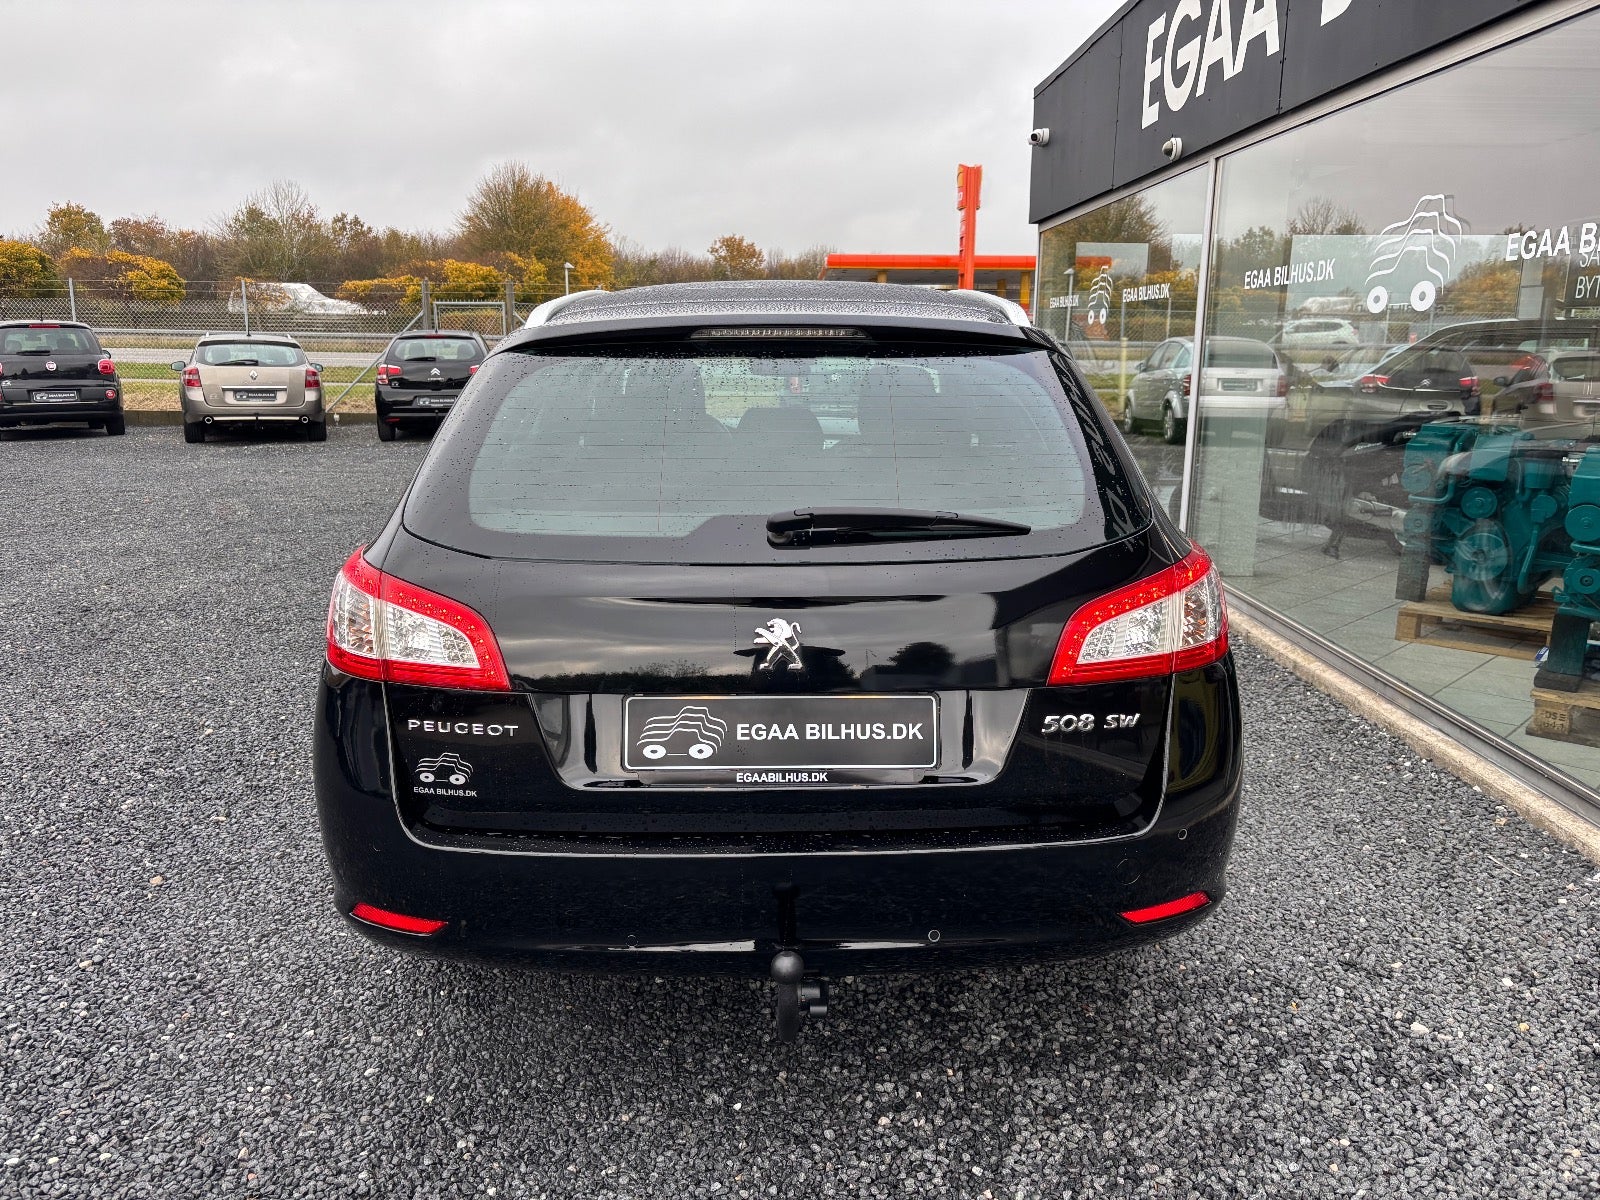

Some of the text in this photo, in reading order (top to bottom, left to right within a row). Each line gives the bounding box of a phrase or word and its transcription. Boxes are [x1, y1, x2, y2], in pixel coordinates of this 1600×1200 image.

[1142, 0, 1280, 130] EGAA
[1505, 225, 1570, 262] EGAA
[1244, 258, 1336, 290] EGAA BILHUS.DK
[1122, 283, 1171, 303] EGAA BILHUS.DK
[407, 719, 519, 737] PEUGEOT
[736, 722, 924, 741] EGAA BILHUS.DK
[1041, 712, 1141, 734] 508 SW
[736, 771, 829, 783] EGAABILHUS.DK
[413, 786, 478, 798] EGAA BILHUS.DK
